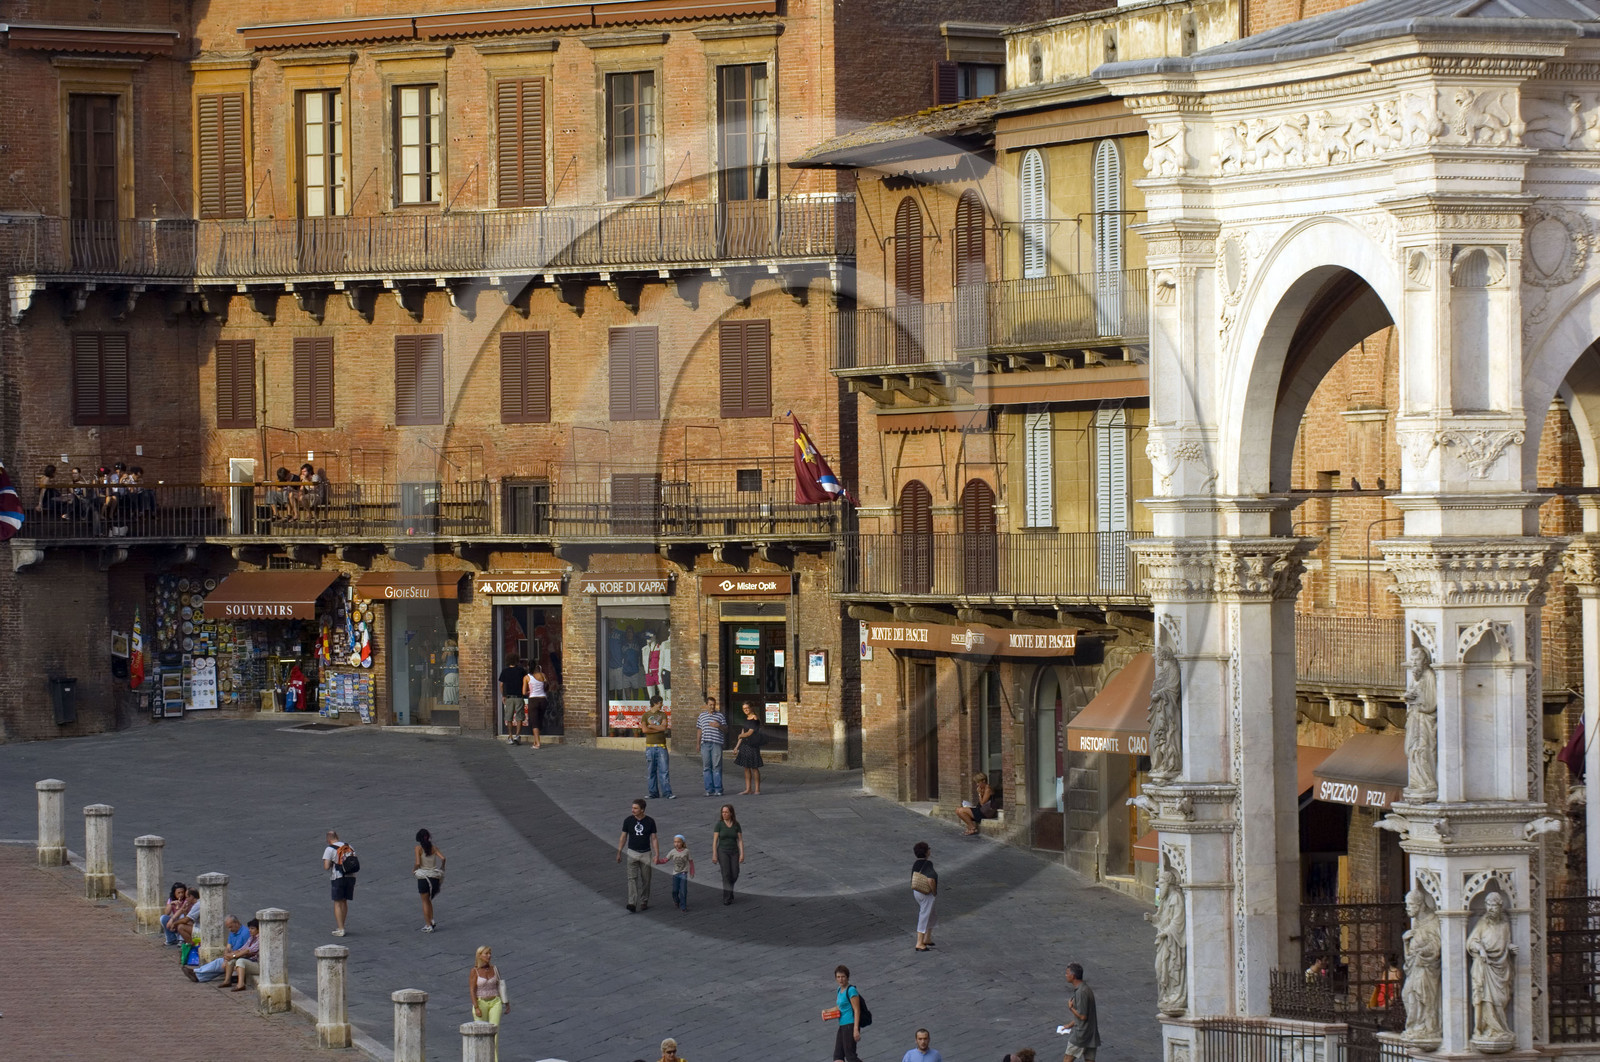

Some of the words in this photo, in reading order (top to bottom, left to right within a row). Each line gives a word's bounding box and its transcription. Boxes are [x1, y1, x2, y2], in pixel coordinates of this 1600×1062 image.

[496, 581, 519, 593] ROBE
[520, 581, 531, 593] DI
[532, 581, 560, 593] KAPPA
[600, 581, 624, 593] ROBE
[626, 581, 636, 593] DI
[638, 581, 666, 593] KAPPA
[737, 582, 758, 590] Mister
[758, 581, 777, 592] Optik
[225, 604, 293, 616] SOUVENIRS
[871, 626, 893, 641] MONTE
[893, 627, 904, 641] DEI
[905, 627, 929, 643] PASCHI
[1009, 633, 1034, 648] MONTE
[1035, 634, 1047, 648] DEI
[1048, 634, 1076, 648] PASCHI
[1080, 736, 1119, 752] RISTORANTE
[1128, 735, 1148, 754] CIAO
[1320, 781, 1359, 804] SPIZZICO
[1366, 790, 1386, 807] PIZZA
